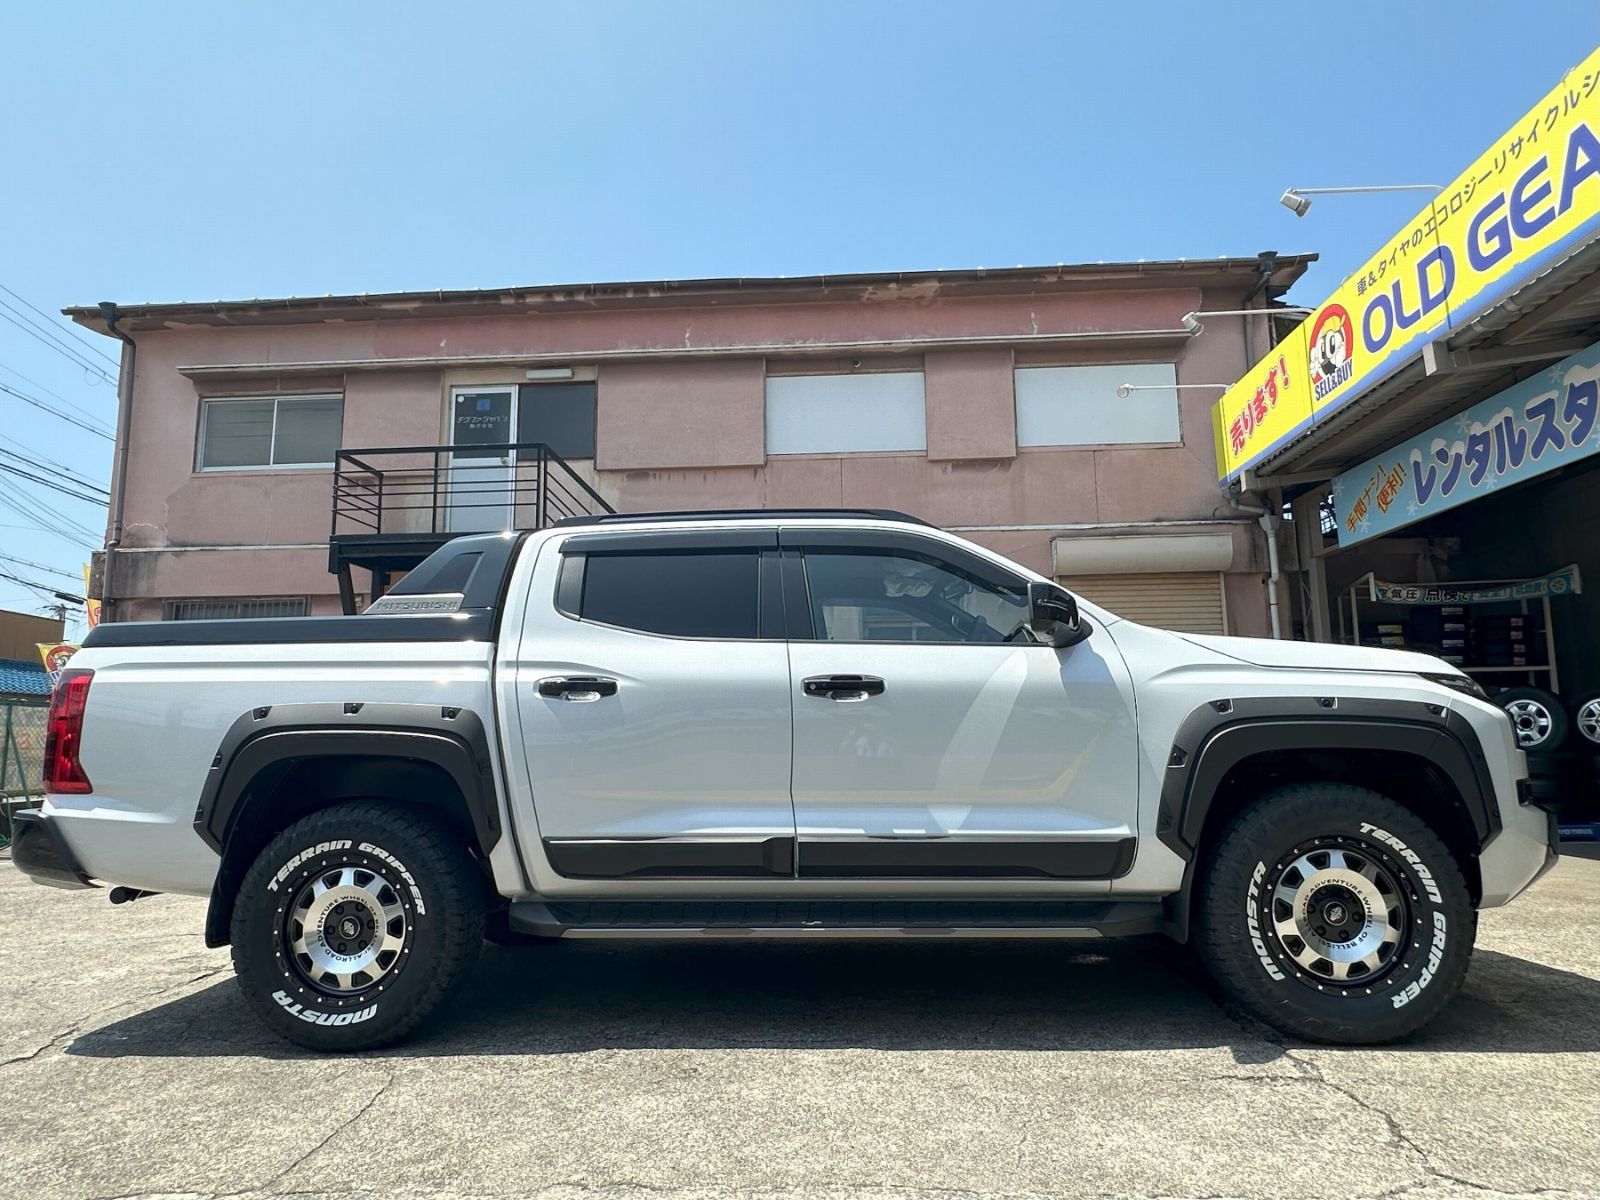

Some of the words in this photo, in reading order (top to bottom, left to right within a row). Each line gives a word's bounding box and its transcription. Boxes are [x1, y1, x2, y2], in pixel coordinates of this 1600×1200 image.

[1363, 245, 1455, 353] OLD
[1314, 359, 1353, 401] SELL&BUY
[1410, 379, 1599, 505] レンタルスタ
[377, 601, 458, 610] MITSUBISHI
[267, 839, 352, 892] TERRAIN
[358, 842, 426, 915] GRIPPER
[1359, 822, 1443, 904] TERRAIN
[316, 898, 339, 948] ADVENTURE
[1310, 879, 1363, 896] ADVENTURE
[1362, 896, 1373, 929] WHEEL
[1390, 910, 1447, 1009] GRIPPER
